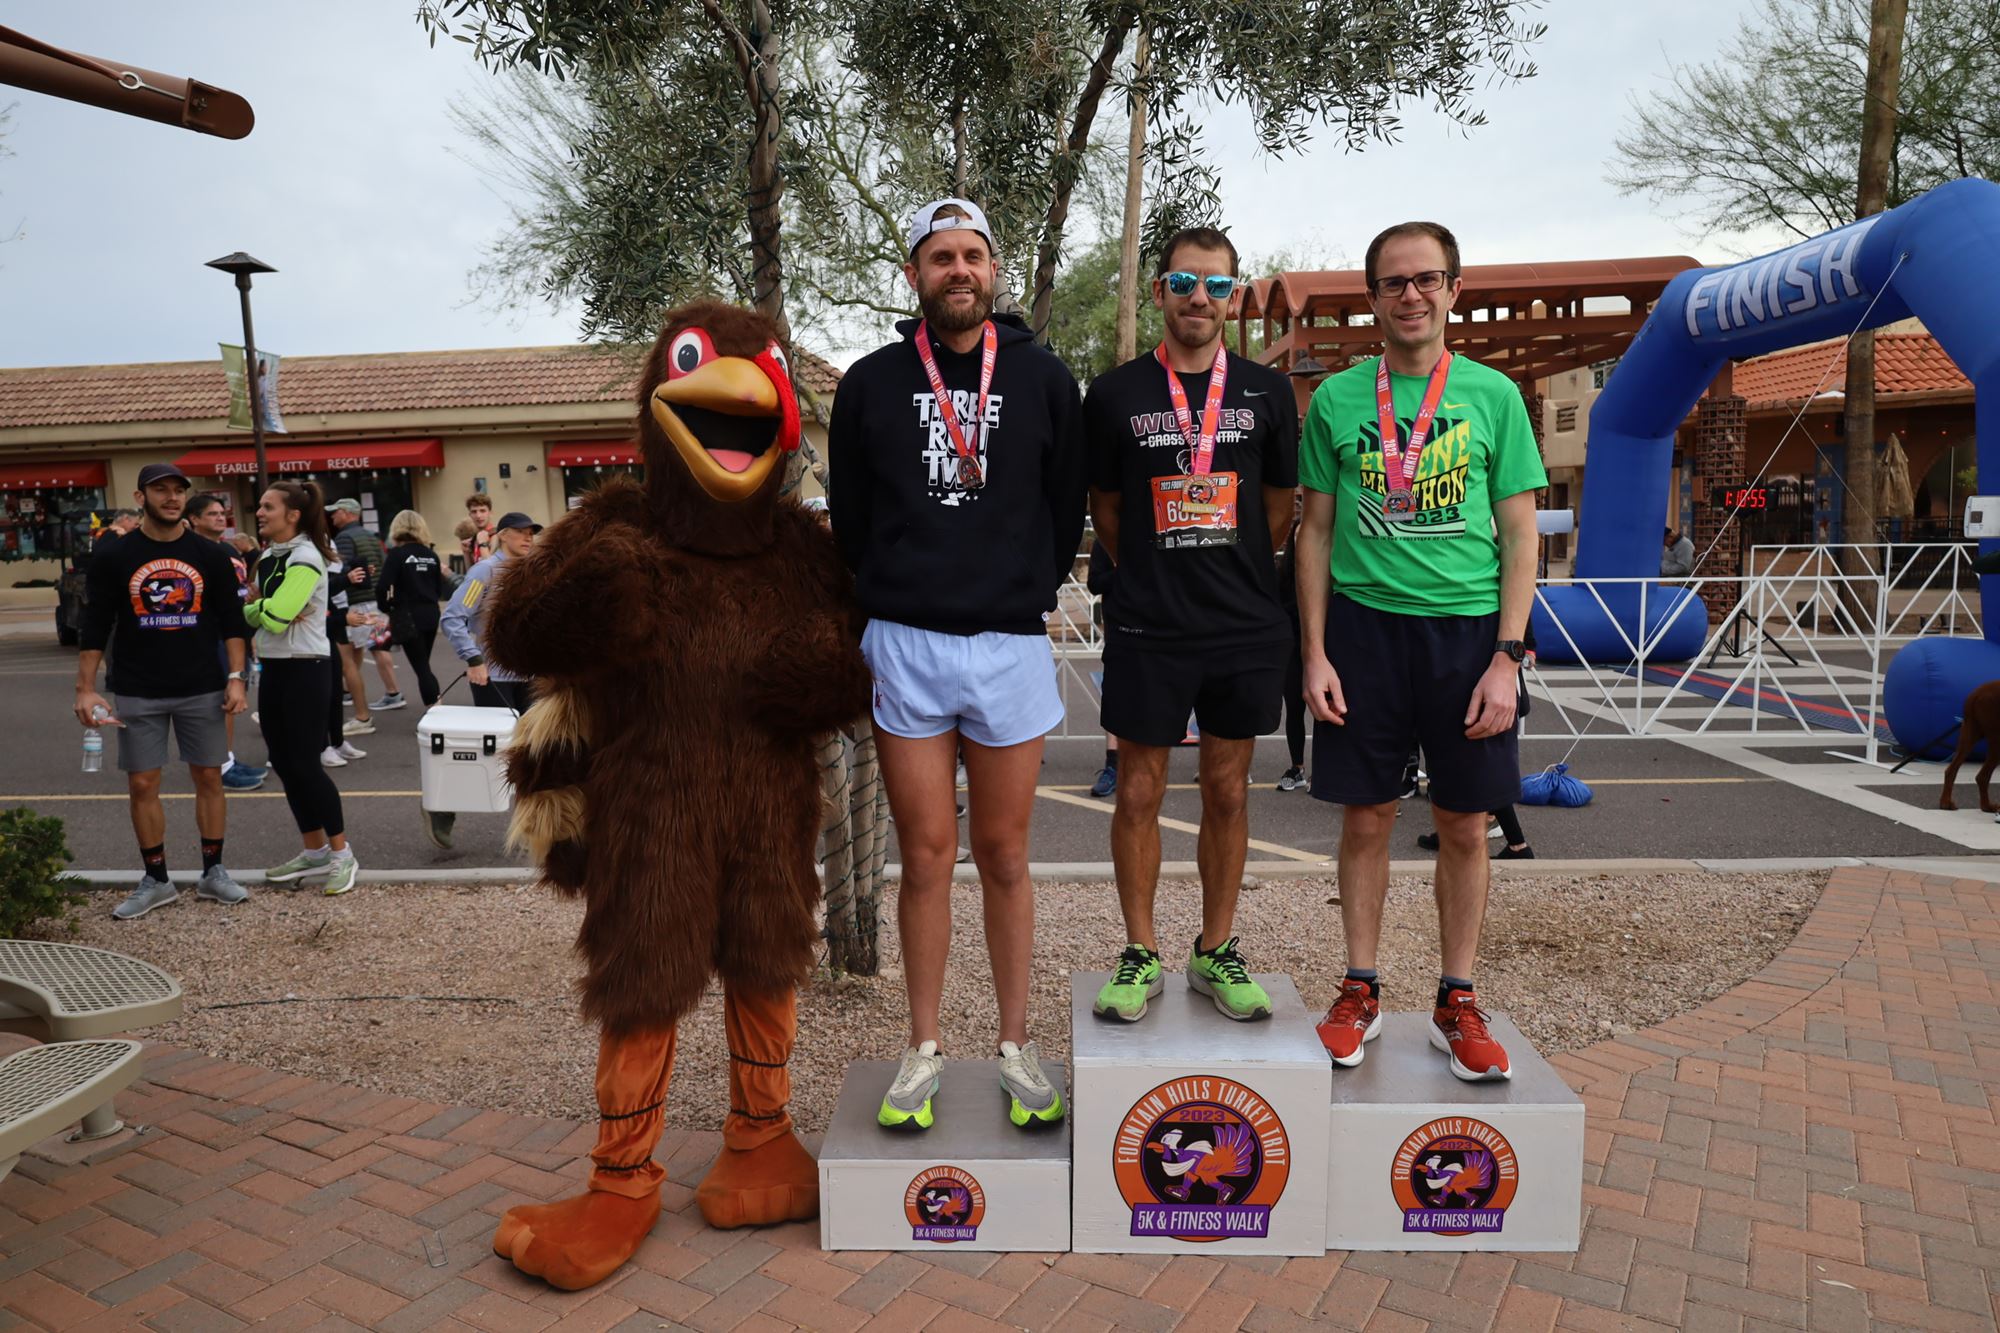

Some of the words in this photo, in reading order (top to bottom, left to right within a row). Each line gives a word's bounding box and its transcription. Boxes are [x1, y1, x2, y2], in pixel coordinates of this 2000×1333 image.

[1685, 232, 1862, 336] FINISH
[984, 348, 995, 366] TROT
[924, 357, 939, 386] TURKEY
[935, 384, 949, 405] TROT
[1148, 433, 1185, 448] CROSS
[1190, 431, 1241, 446] CNTRY
[1200, 434, 1214, 453] 2023
[1384, 438, 1398, 457] 2023
[1410, 431, 1425, 449] TROT
[1360, 420, 1471, 482] EUENE
[215, 462, 259, 474] FEARLES
[279, 461, 312, 472] KITTY
[327, 457, 369, 469] RESCUE
[1403, 450, 1419, 479] TURKEY
[1361, 466, 1468, 511] MATHON
[1404, 506, 1460, 524] 023
[155, 616, 180, 625] FITNESS
[181, 615, 197, 624] WALK
[1117, 1094, 1167, 1164] FOUNTAIN
[1165, 1080, 1210, 1104] HILLS
[1217, 1082, 1272, 1127] TURKEY
[1260, 1127, 1286, 1166] TROT
[1179, 1110, 1226, 1122] 2023
[1394, 1129, 1430, 1180] FOUNTAIN
[1429, 1119, 1462, 1138] HILLS
[1466, 1121, 1506, 1153] TURKEY
[1498, 1152, 1515, 1180] TROT
[1439, 1141, 1473, 1150] 2023
[1138, 1212, 1155, 1230] 5K
[1157, 1212, 1167, 1230] &
[1170, 1211, 1222, 1231] FITNESS
[1225, 1211, 1264, 1231] WALK
[1408, 1214, 1421, 1227] 5K
[1422, 1214, 1430, 1227] &
[1431, 1213, 1469, 1228] FITNESS
[1471, 1213, 1500, 1227] WALK
[916, 1228, 925, 1237] 5K
[925, 1228, 930, 1237] &
[931, 1227, 955, 1238] FITNESS
[956, 1228, 974, 1238] WALK
